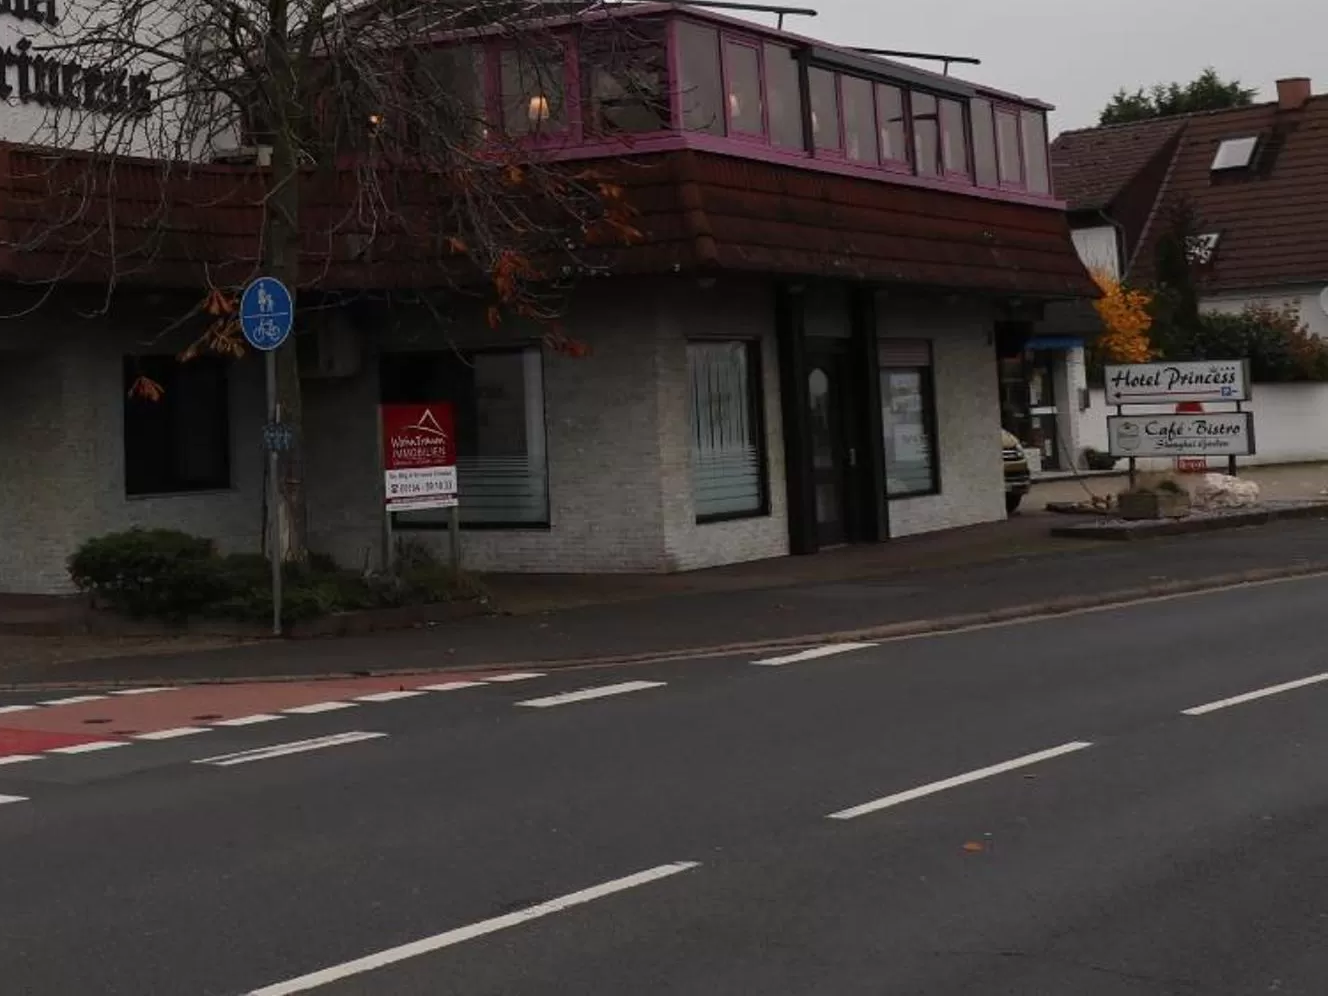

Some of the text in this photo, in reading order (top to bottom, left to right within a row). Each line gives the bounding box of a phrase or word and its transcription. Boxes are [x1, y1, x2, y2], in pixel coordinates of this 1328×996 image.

[1111, 366, 1236, 391] Hotel Princess
[1145, 419, 1241, 442] Café Bistro
